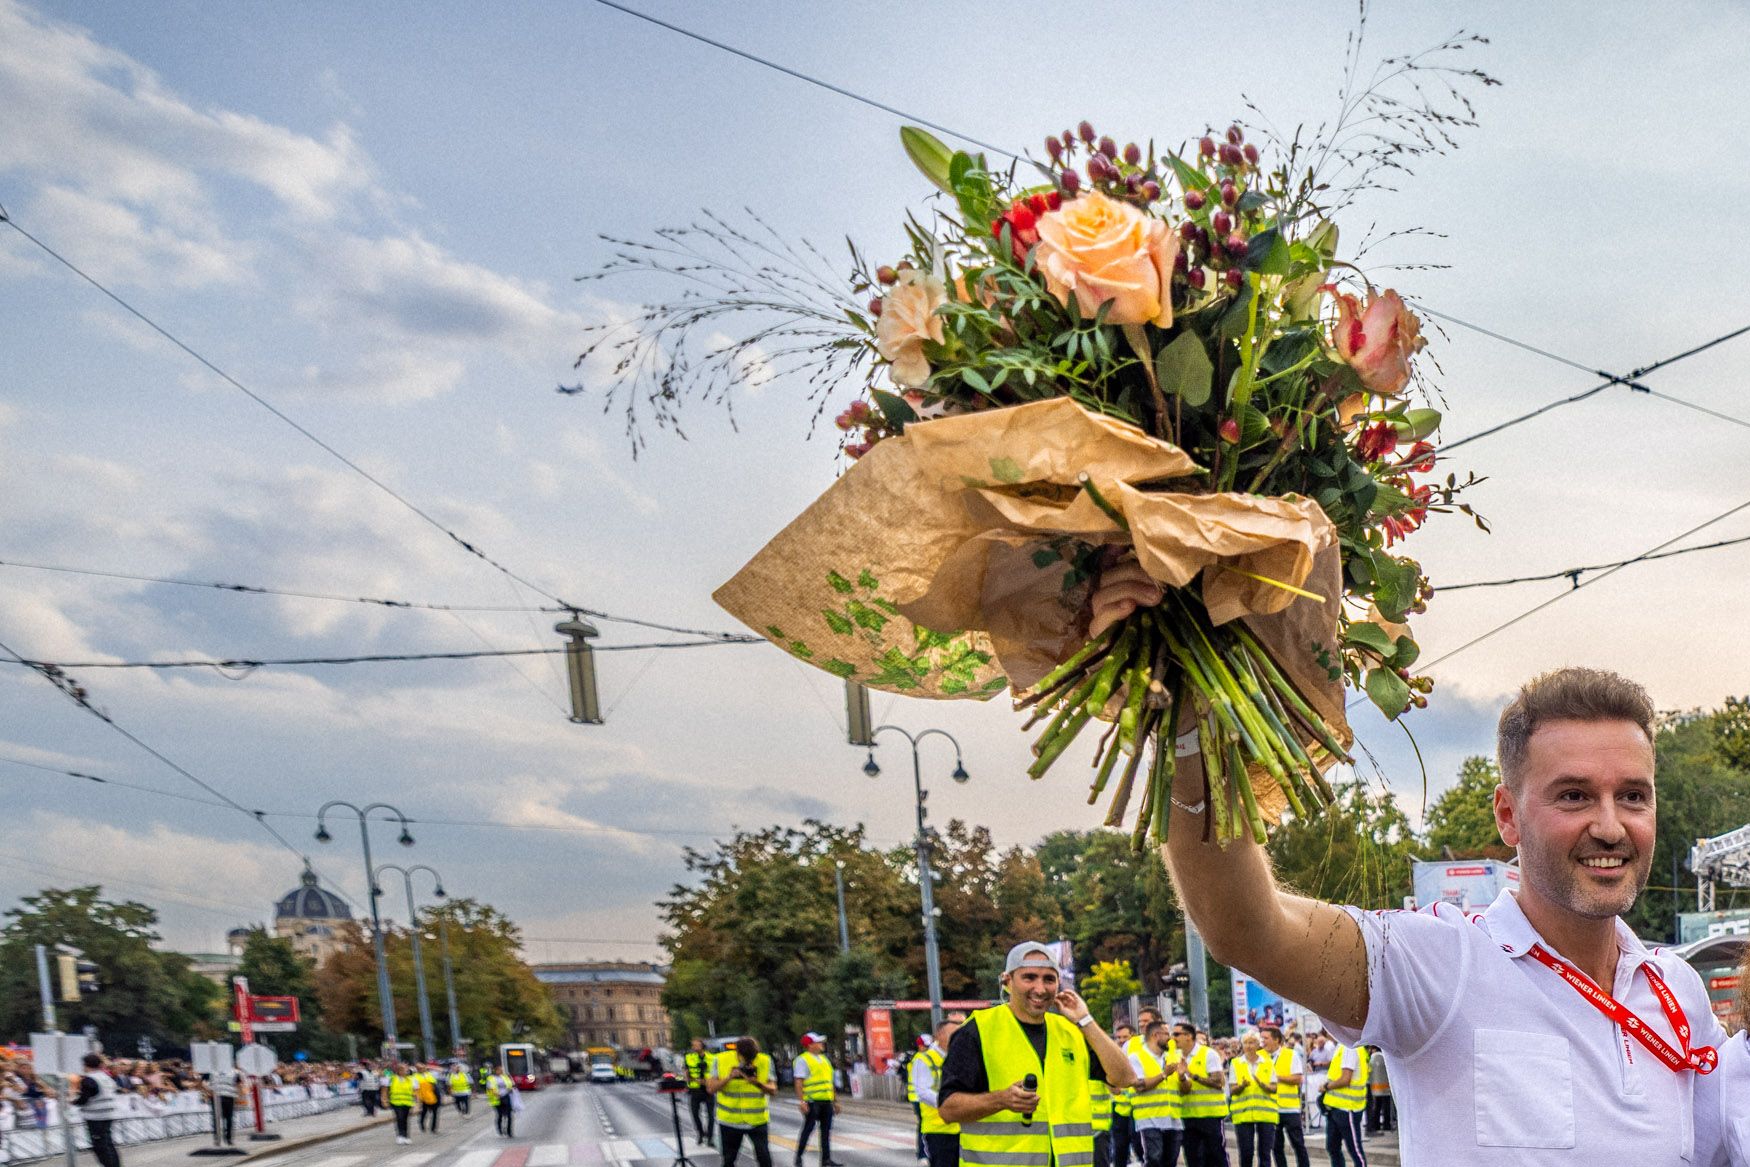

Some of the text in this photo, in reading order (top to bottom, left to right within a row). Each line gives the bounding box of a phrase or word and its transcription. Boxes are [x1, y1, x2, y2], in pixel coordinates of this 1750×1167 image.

[1565, 970, 1617, 1013] WIENER LINIEN
[1660, 988, 1679, 1014] LINIEN
[1639, 1026, 1663, 1051] WIENER
[1660, 1047, 1681, 1067] LINIEN
